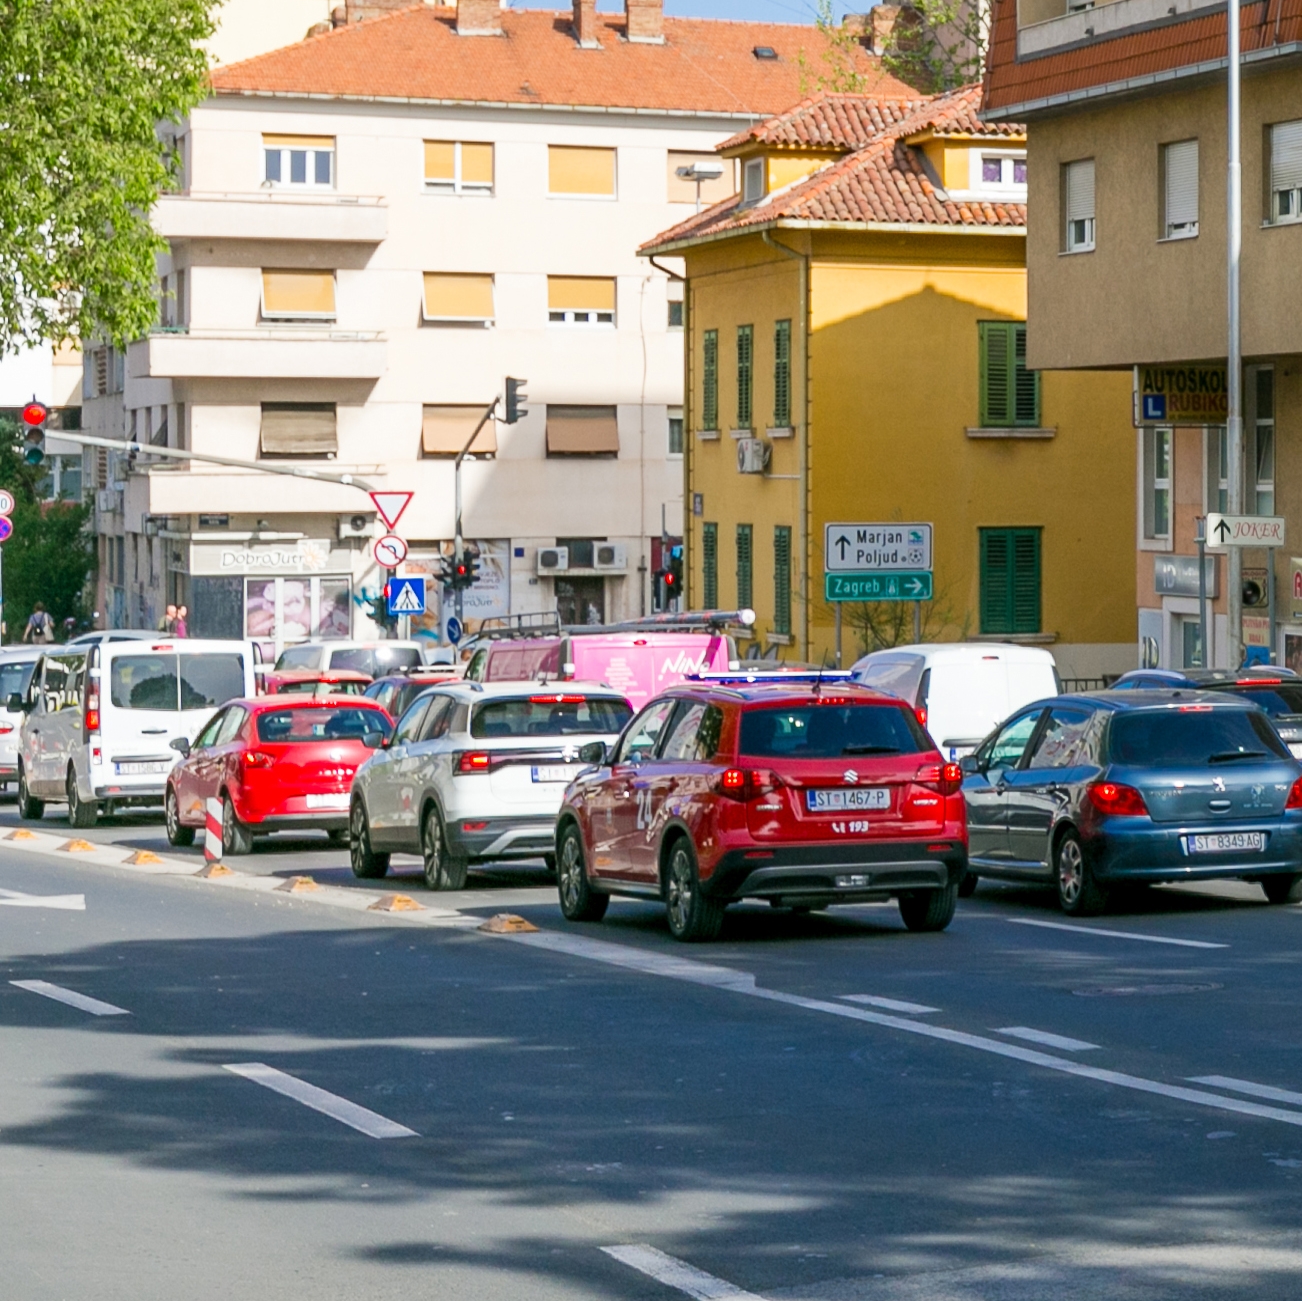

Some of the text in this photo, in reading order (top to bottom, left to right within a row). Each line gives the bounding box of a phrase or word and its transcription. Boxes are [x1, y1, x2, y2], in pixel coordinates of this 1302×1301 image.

[1143, 368, 1228, 393] AUTOŠKOL
[1168, 394, 1229, 411] RUBIKO
[857, 529, 902, 547] Marjan
[1233, 521, 1283, 541] JOKER
[857, 549, 898, 566] Poljud
[834, 578, 880, 596] Zagreb
[817, 791, 885, 806] ST 1467-P
[848, 821, 869, 832] 193
[1197, 834, 1260, 849] ST 8349-AG
